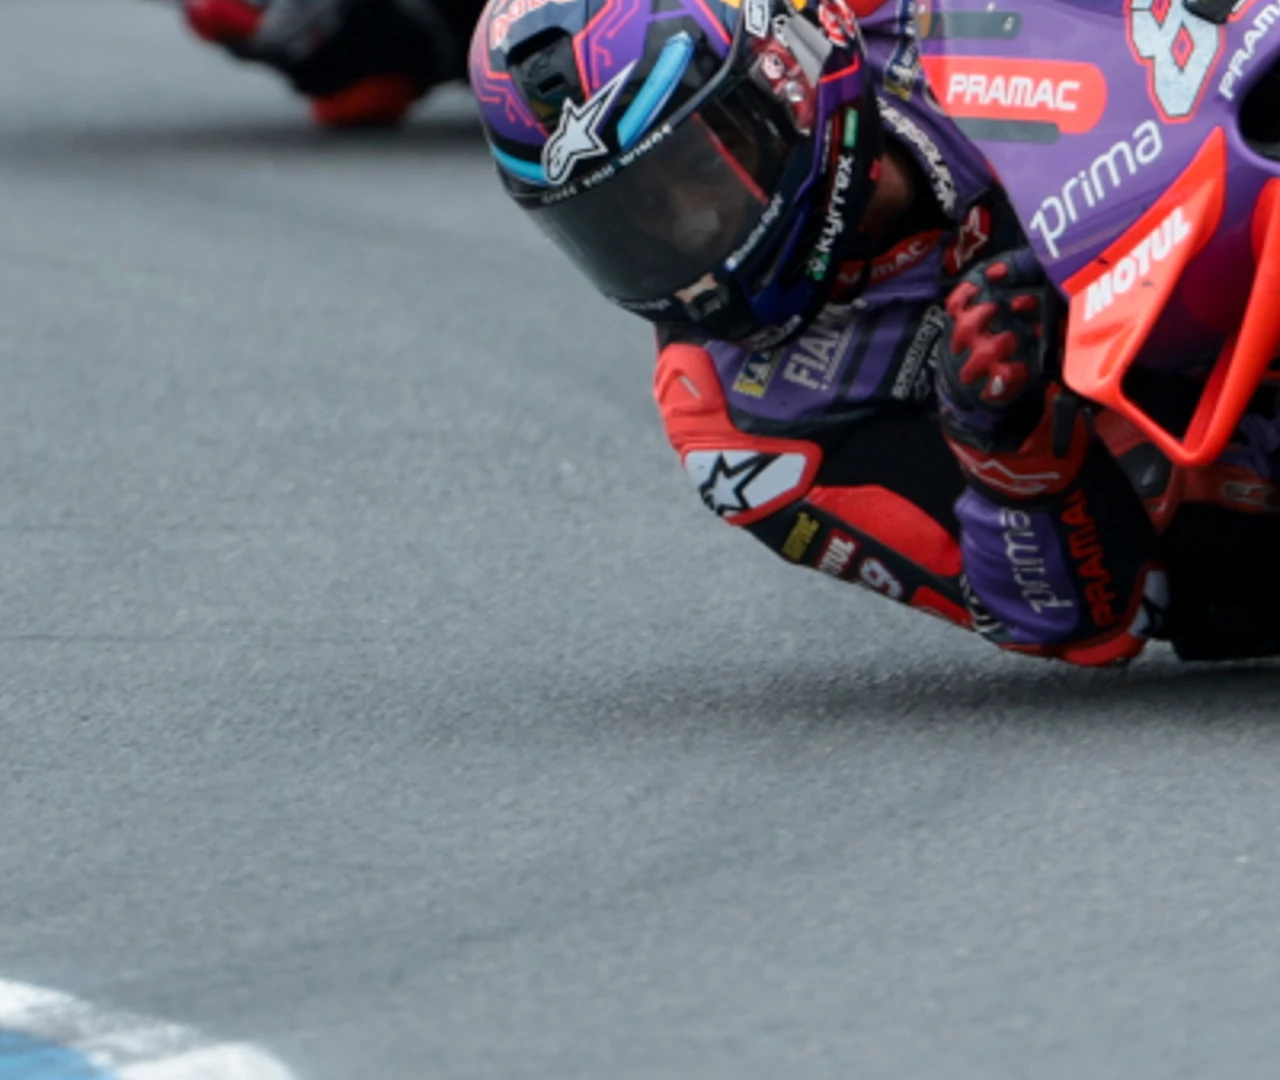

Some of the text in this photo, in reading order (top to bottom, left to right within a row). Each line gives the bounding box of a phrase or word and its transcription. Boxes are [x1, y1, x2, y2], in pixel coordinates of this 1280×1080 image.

[946, 72, 1081, 111] PRAMAC
[816, 153, 855, 253] kyrrex
[1029, 118, 1163, 259] prima
[1083, 206, 1194, 322] MOTUL
[999, 507, 1073, 614] prima
